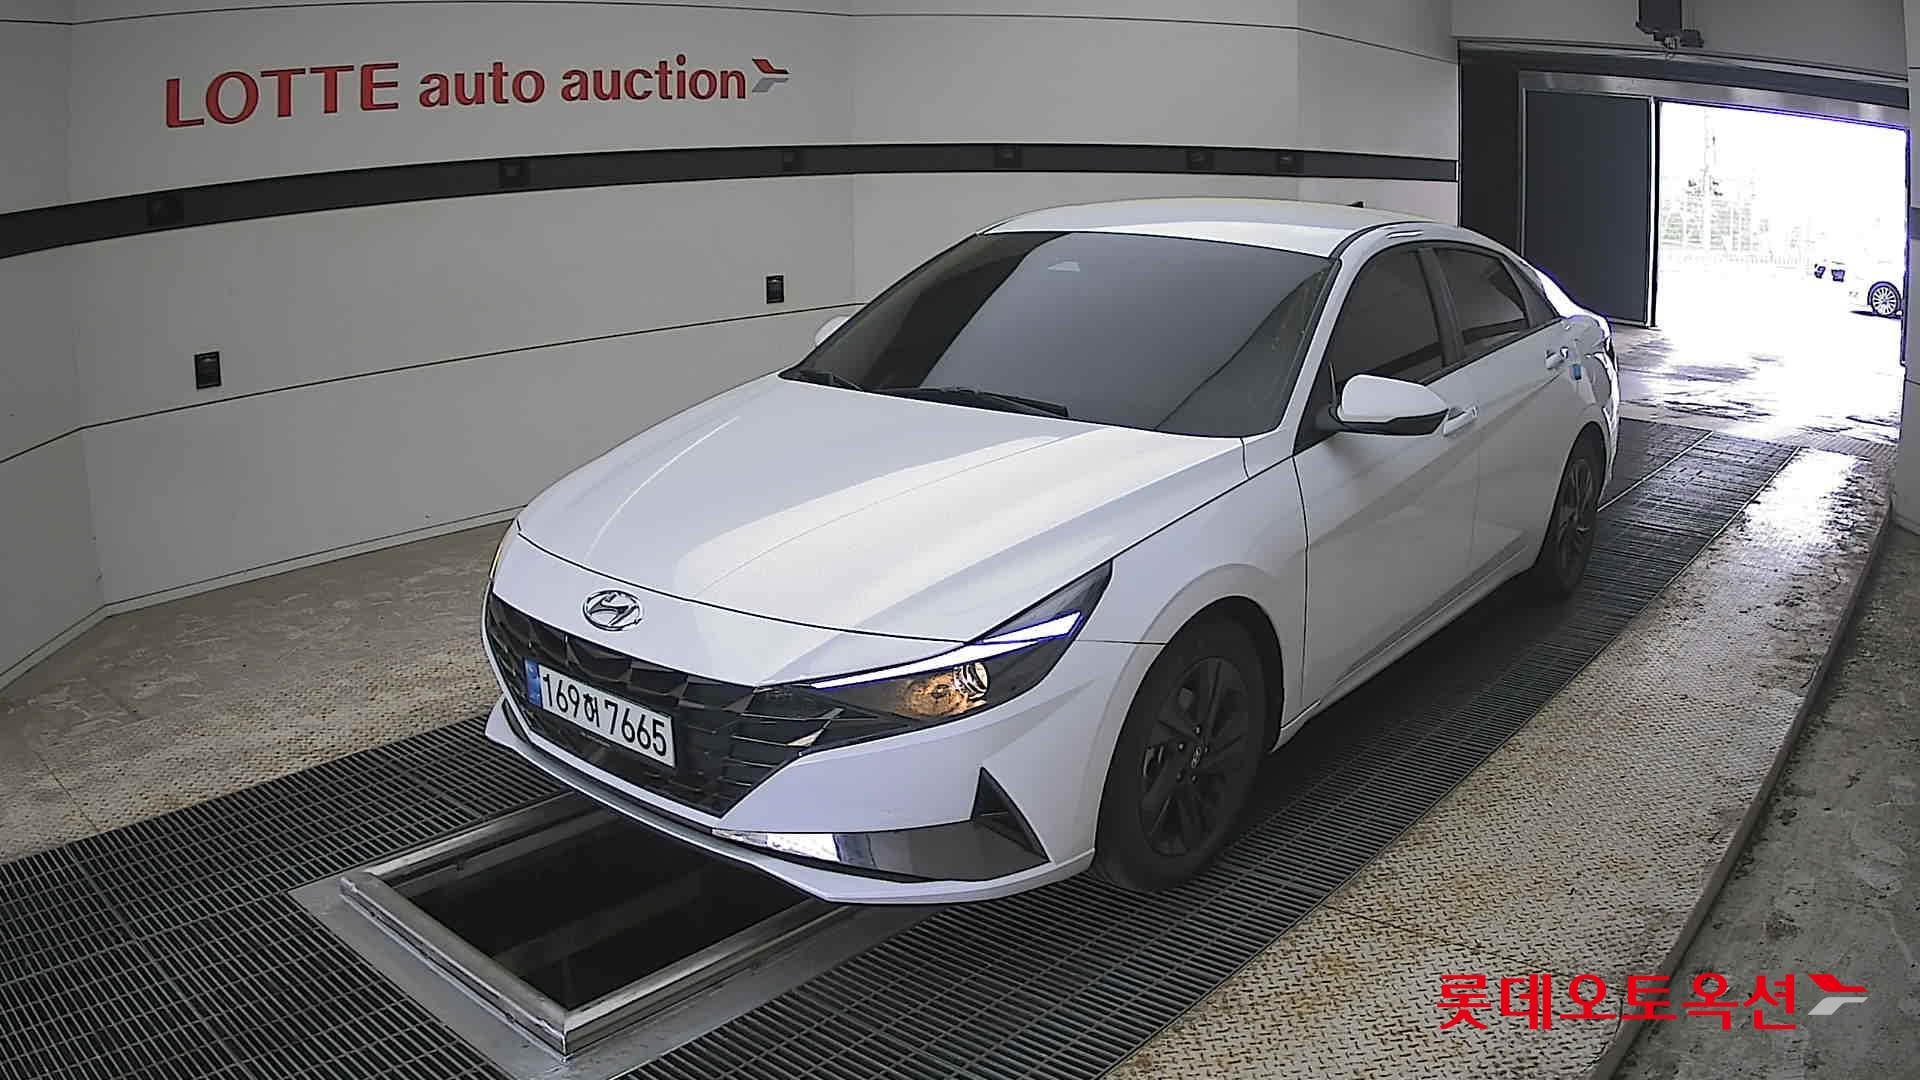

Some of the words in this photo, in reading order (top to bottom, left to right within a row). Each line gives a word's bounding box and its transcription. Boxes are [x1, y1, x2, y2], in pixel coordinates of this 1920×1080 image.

[165, 62, 400, 128] LOTTE
[418, 61, 546, 107] auto
[561, 53, 748, 102] auction
